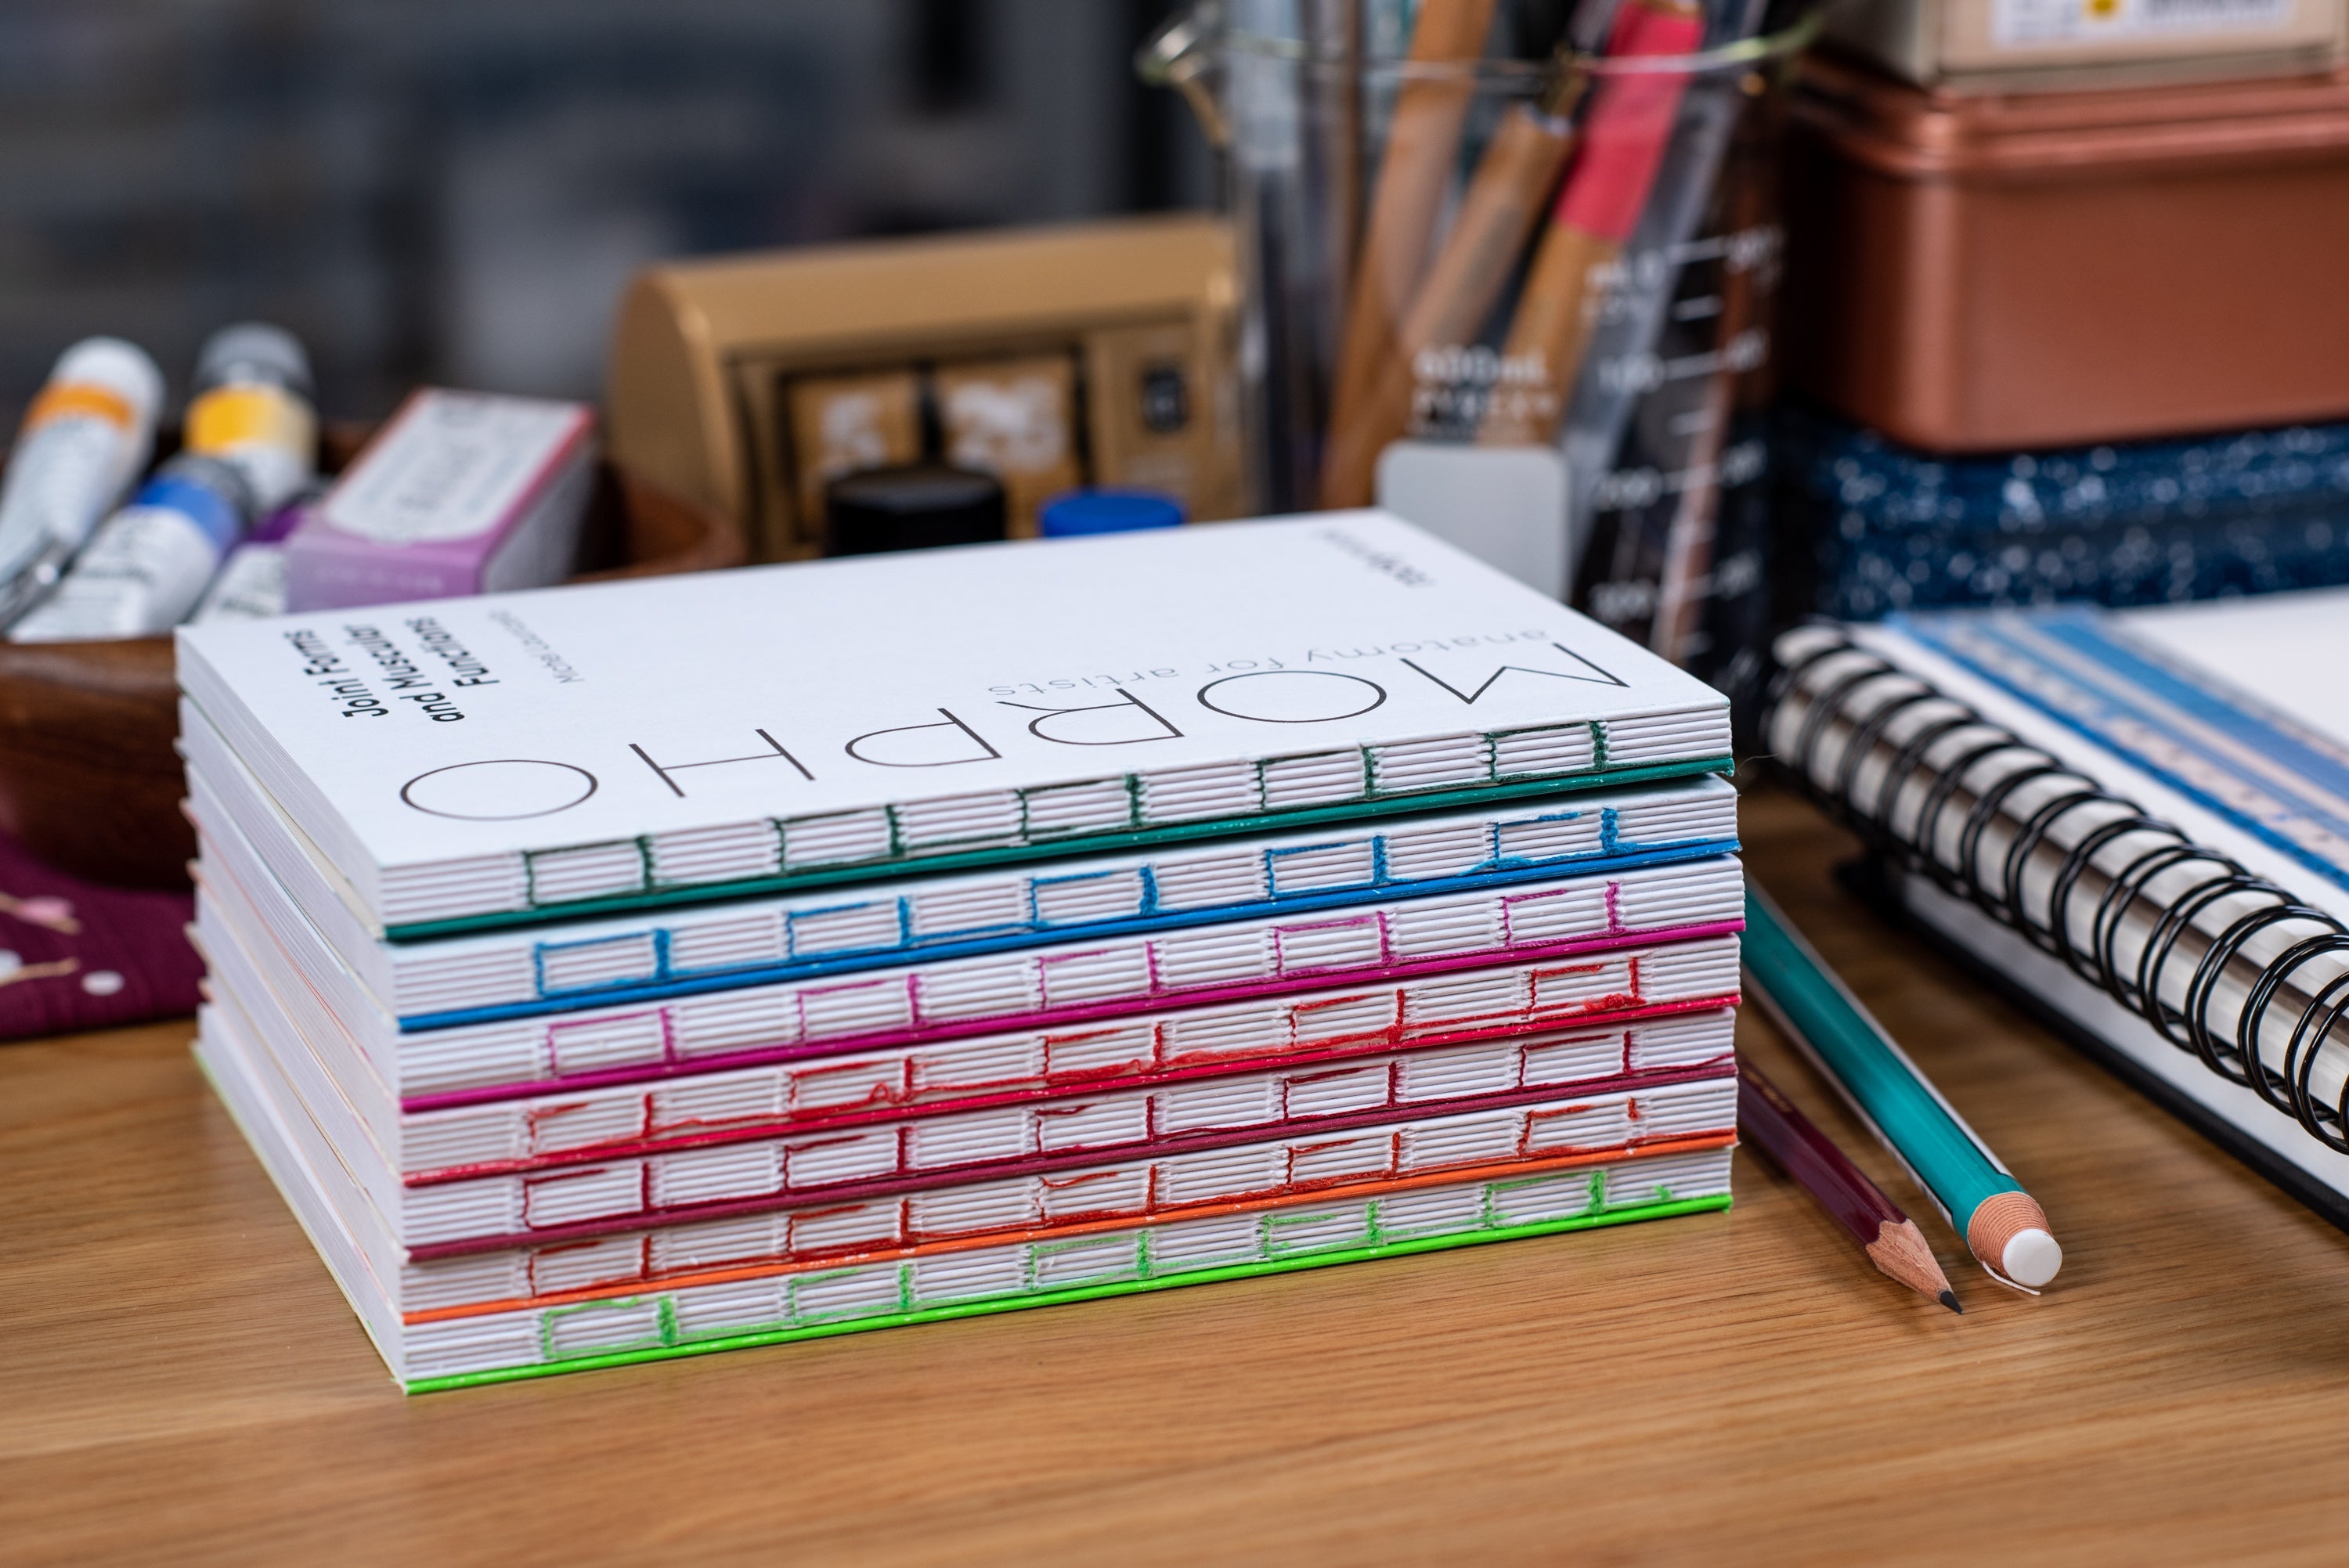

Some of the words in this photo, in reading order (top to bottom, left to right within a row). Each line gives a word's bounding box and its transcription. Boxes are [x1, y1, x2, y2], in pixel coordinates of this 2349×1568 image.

[283, 629, 350, 676] Forms
[342, 624, 433, 690] Muscular
[405, 616, 500, 687] Functions
[1307, 628, 1549, 662] anatomy
[988, 666, 1180, 697] artists
[1205, 656, 1285, 675] for
[318, 677, 389, 717] Joint
[399, 692, 465, 722] and
[399, 642, 1631, 821] MORPHO
